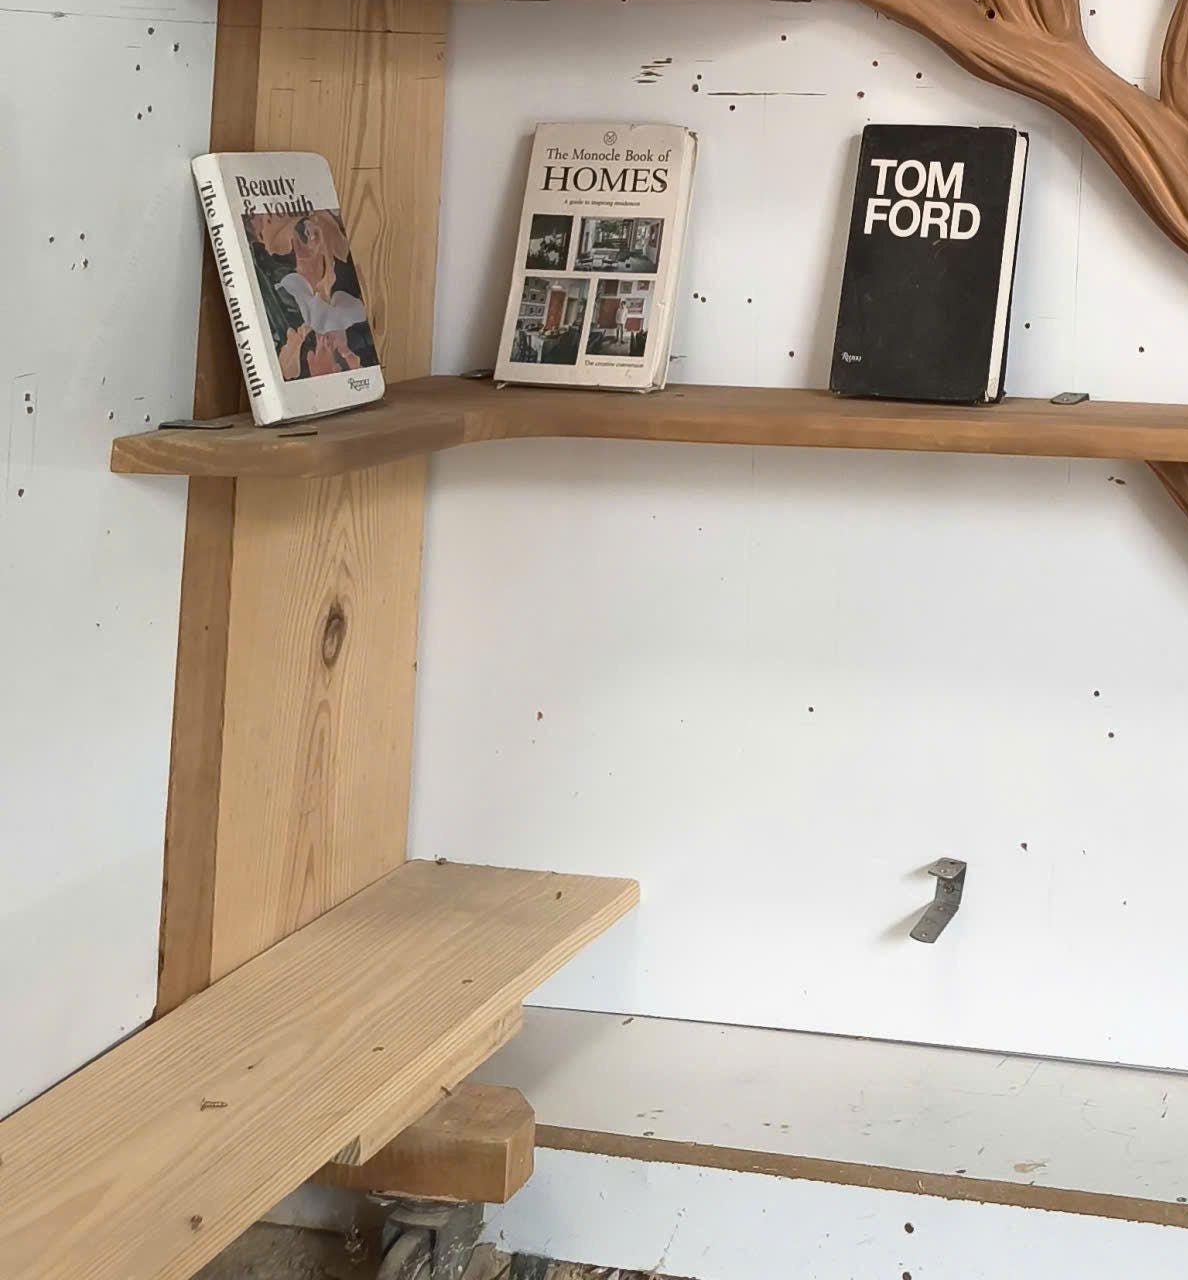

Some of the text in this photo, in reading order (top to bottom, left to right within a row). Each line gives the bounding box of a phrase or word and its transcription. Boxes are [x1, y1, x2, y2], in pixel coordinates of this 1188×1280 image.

[546, 147, 673, 162] The Monocle Book of
[235, 175, 296, 199] Beauty
[540, 165, 669, 193] HOMES
[870, 158, 965, 200] TOM
[243, 195, 315, 222] & youth
[863, 198, 981, 240] FORD
[200, 180, 265, 399] The beauty and youth
